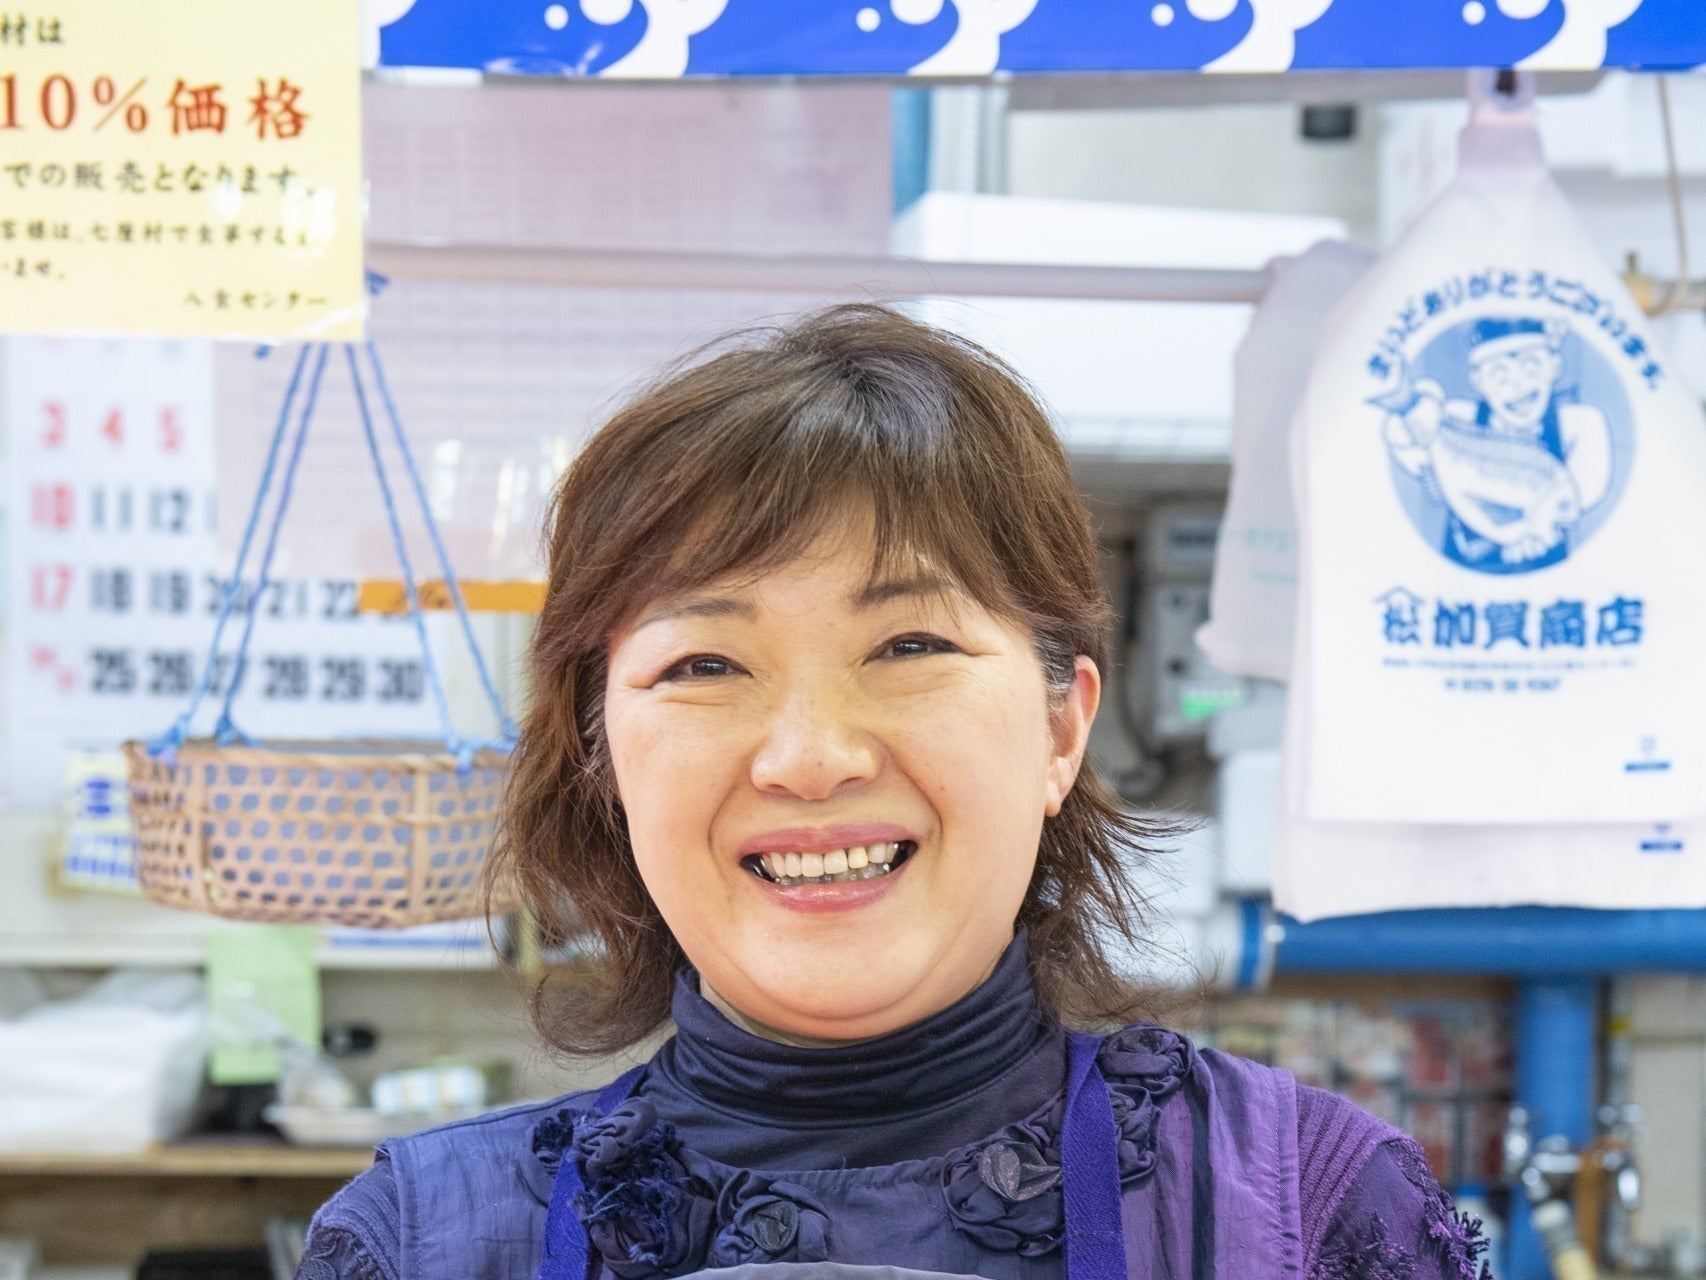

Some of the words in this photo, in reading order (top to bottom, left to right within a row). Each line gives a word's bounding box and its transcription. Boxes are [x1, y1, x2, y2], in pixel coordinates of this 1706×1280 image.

[43, 402, 65, 449] 3
[101, 407, 124, 447] 4
[91, 486, 133, 531] 11
[149, 487, 191, 535] 12
[31, 566, 73, 612] 17
[92, 568, 133, 613] 18
